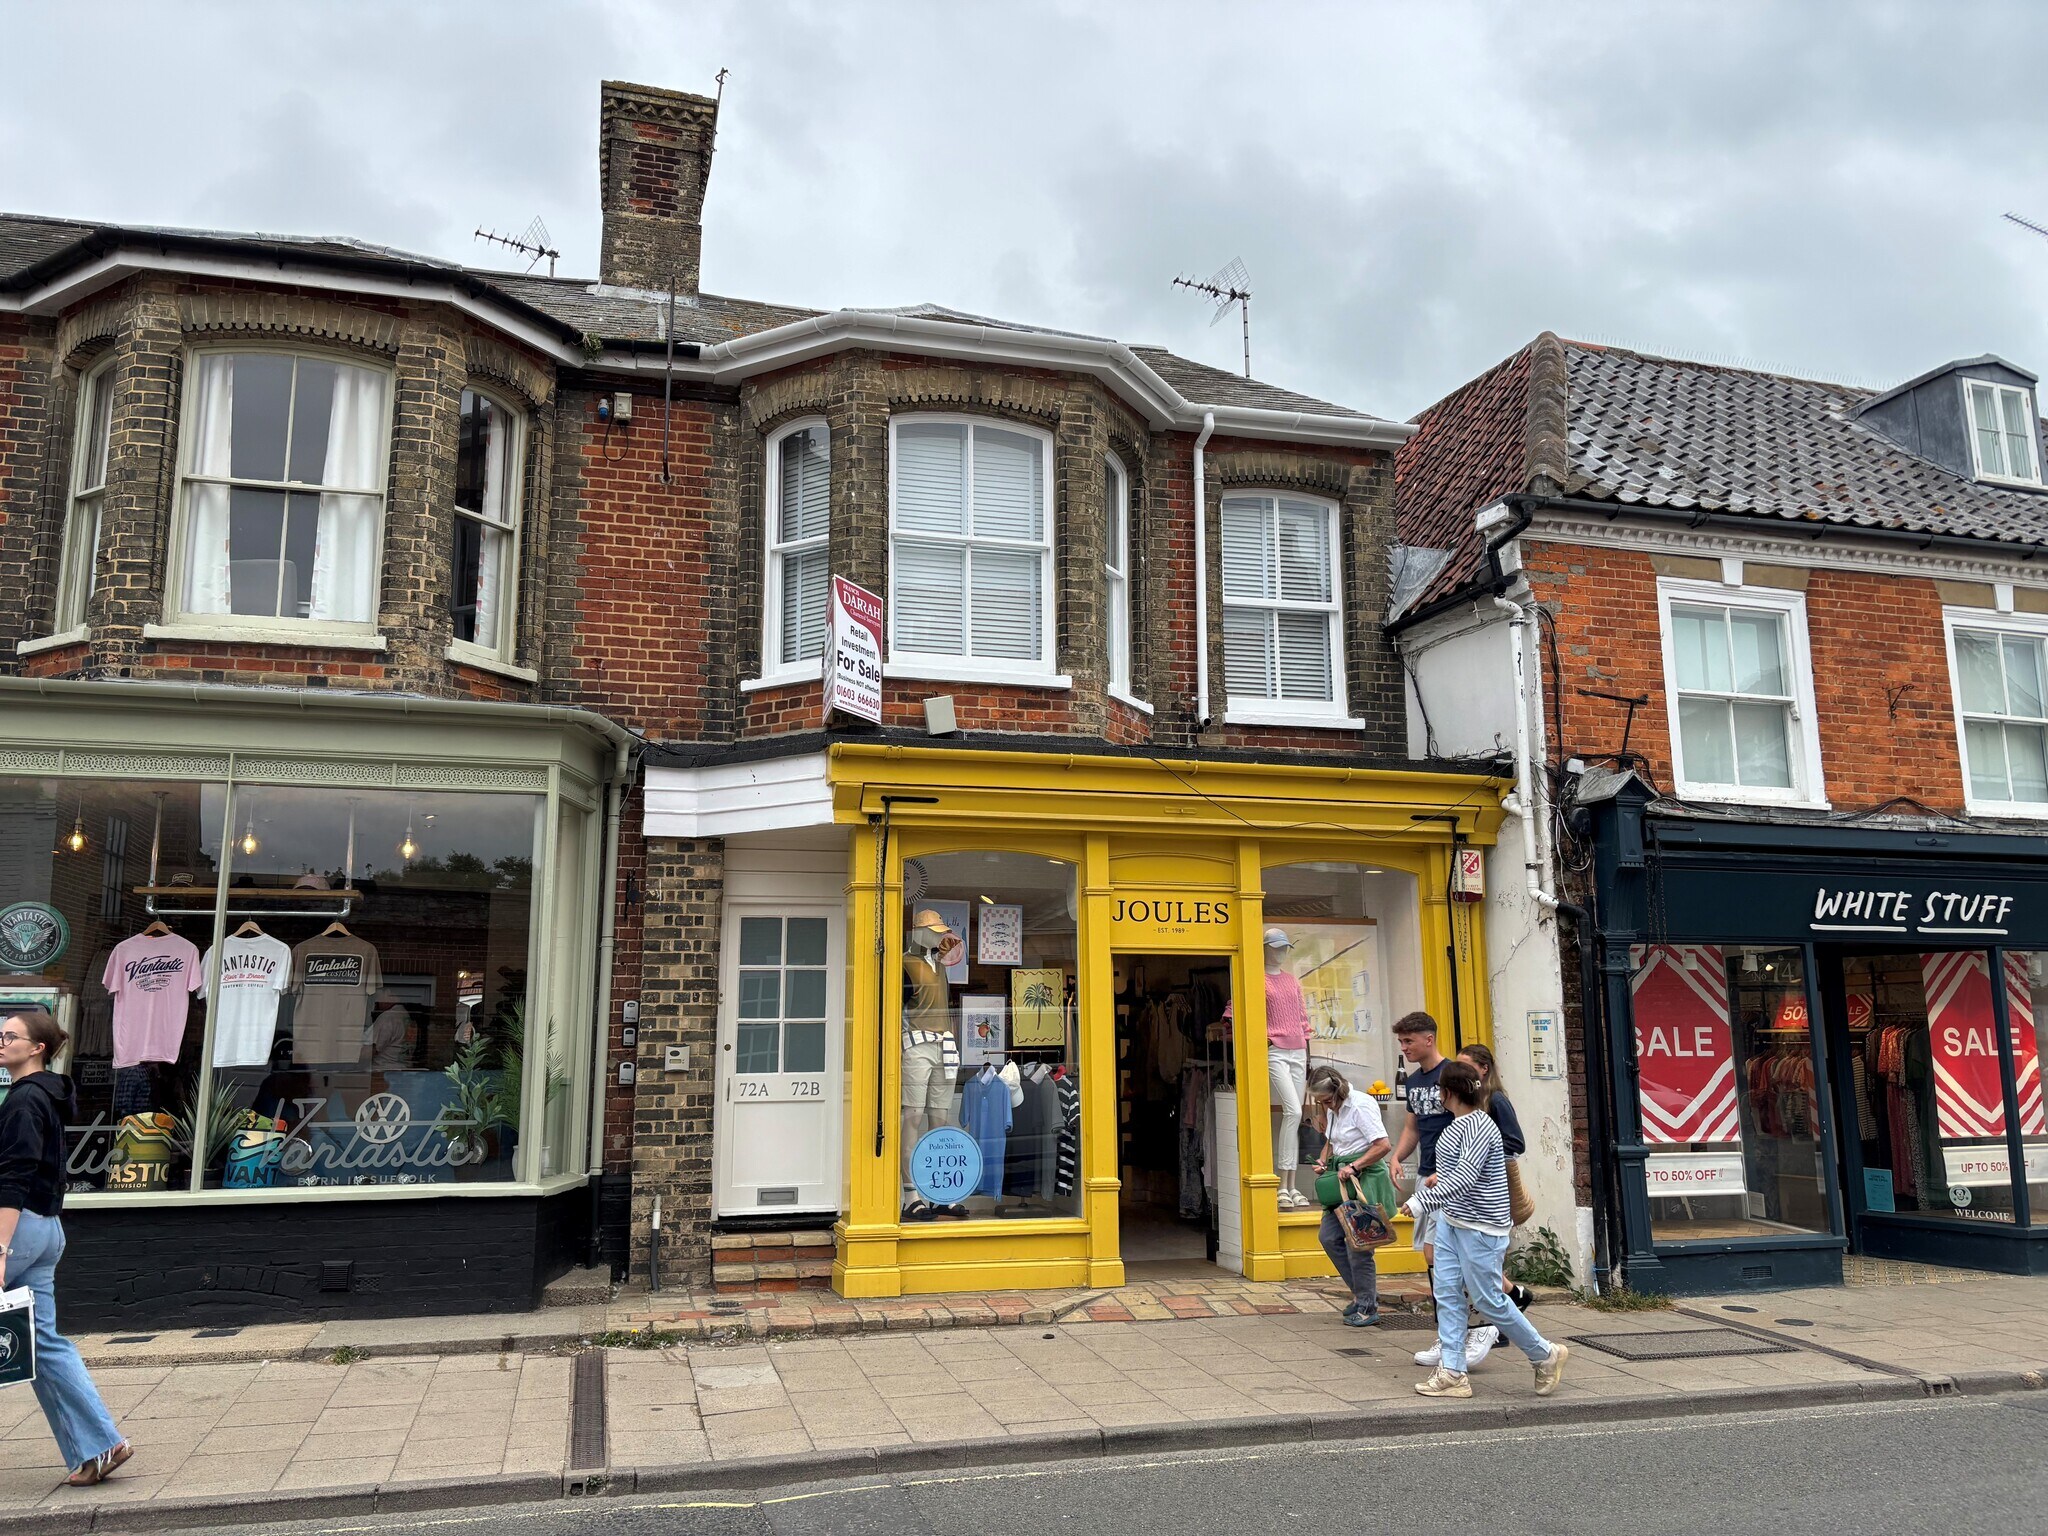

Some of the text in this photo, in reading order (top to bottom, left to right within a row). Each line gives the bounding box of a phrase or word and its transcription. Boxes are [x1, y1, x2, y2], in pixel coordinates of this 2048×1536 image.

[843, 590, 881, 621] DARRAH
[850, 625, 868, 642] Retail
[841, 636, 876, 660] Investment
[836, 649, 880, 683] For Sale
[836, 684, 880, 710] 01603 666630
[1470, 862, 1478, 870] J
[1112, 900, 1230, 924] JOULES
[1814, 887, 2014, 924] WHITE STUFF
[4, 911, 51, 928] VANTASTIC
[0, 941, 53, 961] SINCE FORTY NINE
[125, 955, 184, 983] Vantastic
[220, 954, 276, 975] ANTASTIC
[307, 957, 359, 973] Vantastic
[326, 969, 360, 978] CUSTOMS
[1943, 1027, 2023, 1057] SALE
[739, 1081, 820, 1097] 72A 72B
[259, 1097, 478, 1169] Vantastic
[944, 1142, 964, 1150] Shirts
[925, 1154, 968, 1168] 2 FOR
[1961, 1161, 2009, 1173] UP TO 50%
[107, 1162, 170, 1183] ASTIC
[1653, 1171, 1669, 1181] TO
[1671, 1170, 1693, 1181] 50%
[1695, 1169, 1717, 1180] OFF
[113, 1182, 147, 1190] DIVISION
[1954, 1208, 2010, 1221] WELCOME
